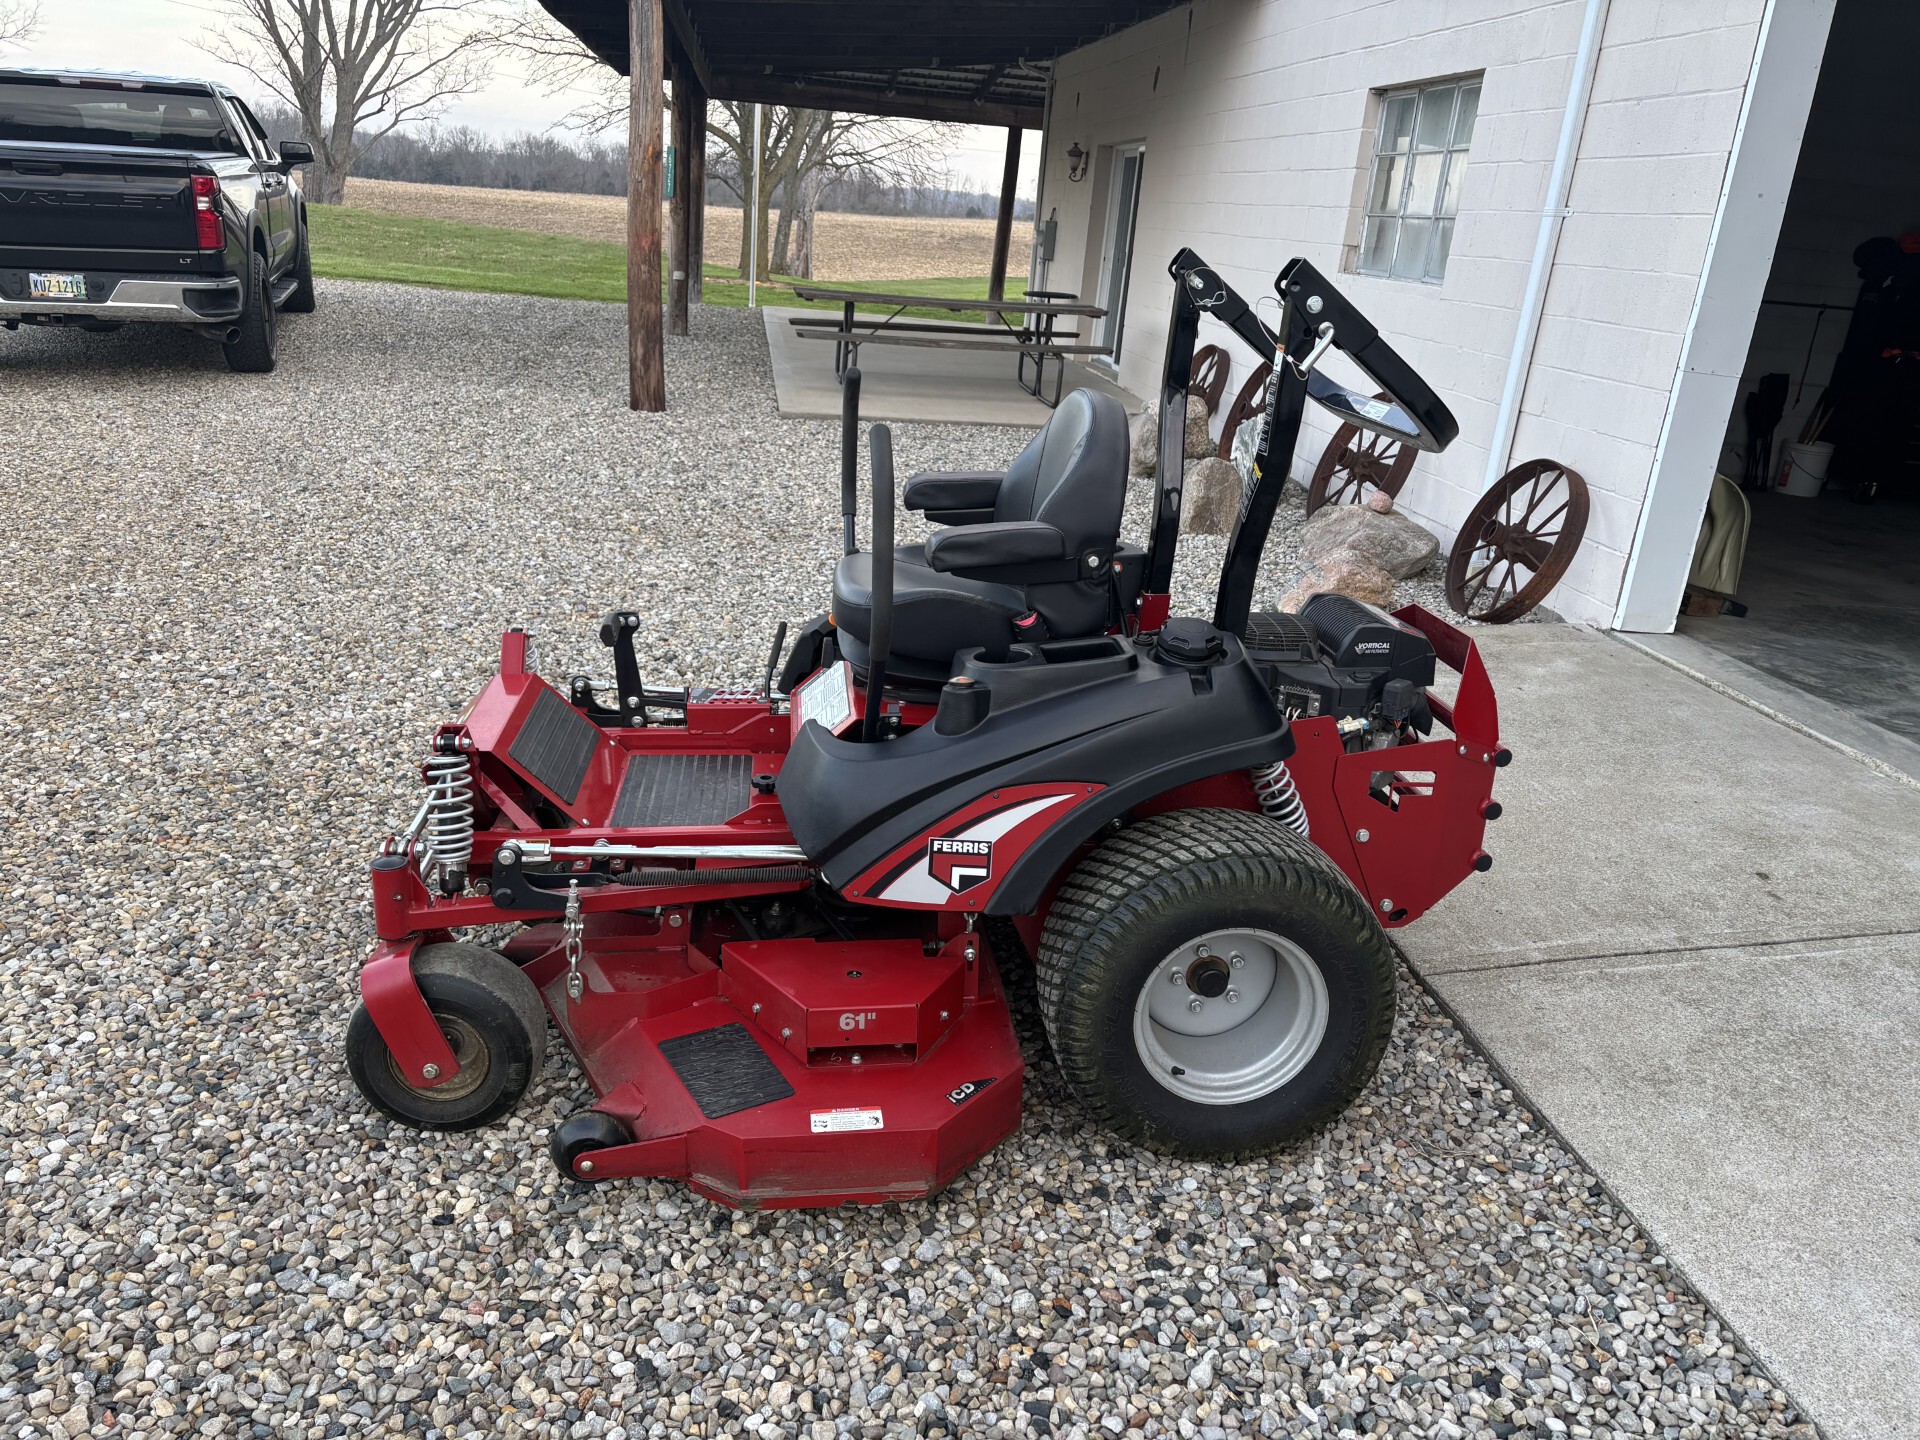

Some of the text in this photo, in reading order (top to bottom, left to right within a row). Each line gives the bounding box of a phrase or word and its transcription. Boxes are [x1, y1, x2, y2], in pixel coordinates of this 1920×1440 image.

[33, 279, 82, 294] KUZ 1216
[933, 840, 989, 854] FERRIS
[839, 1012, 876, 1031] 61"
[946, 1082, 975, 1103] iCD
